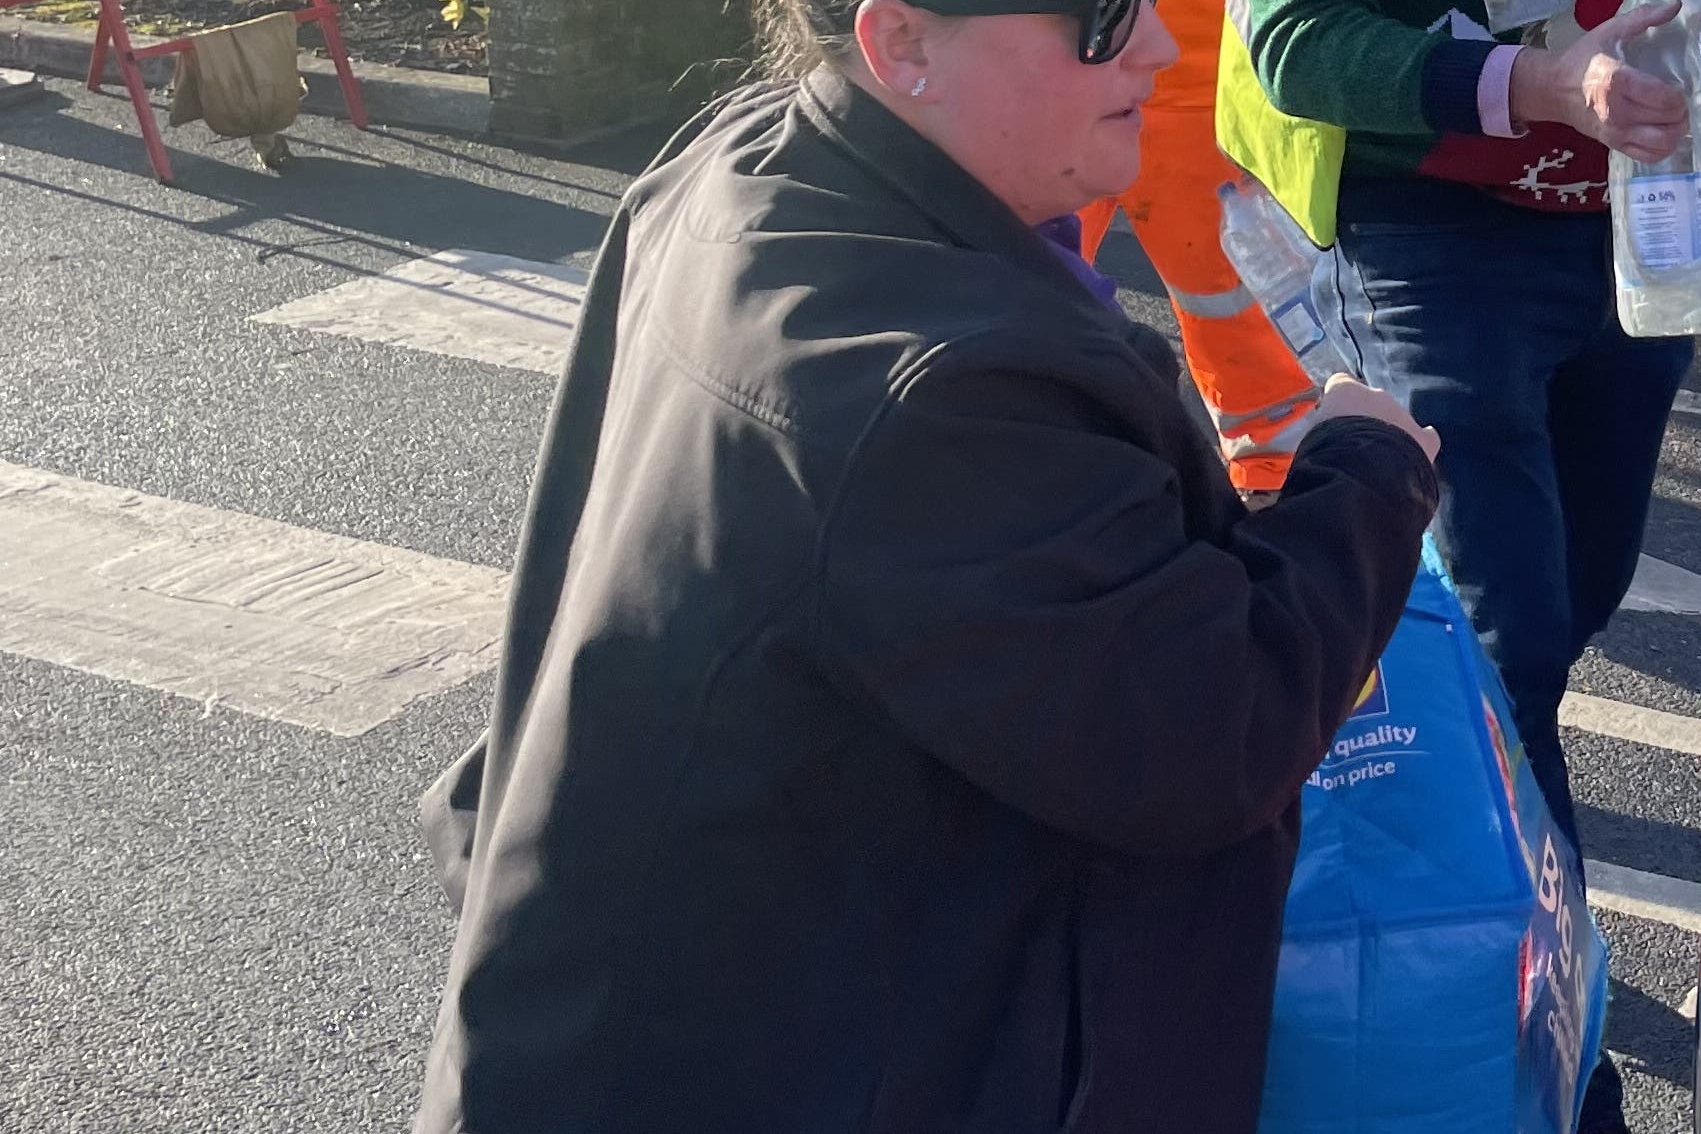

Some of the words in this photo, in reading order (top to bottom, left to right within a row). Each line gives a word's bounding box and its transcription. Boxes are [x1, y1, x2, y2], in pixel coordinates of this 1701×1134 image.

[1334, 724, 1417, 757] quality
[1322, 773, 1345, 791] on
[1348, 760, 1396, 786] price
[1538, 833, 1573, 979] Big
